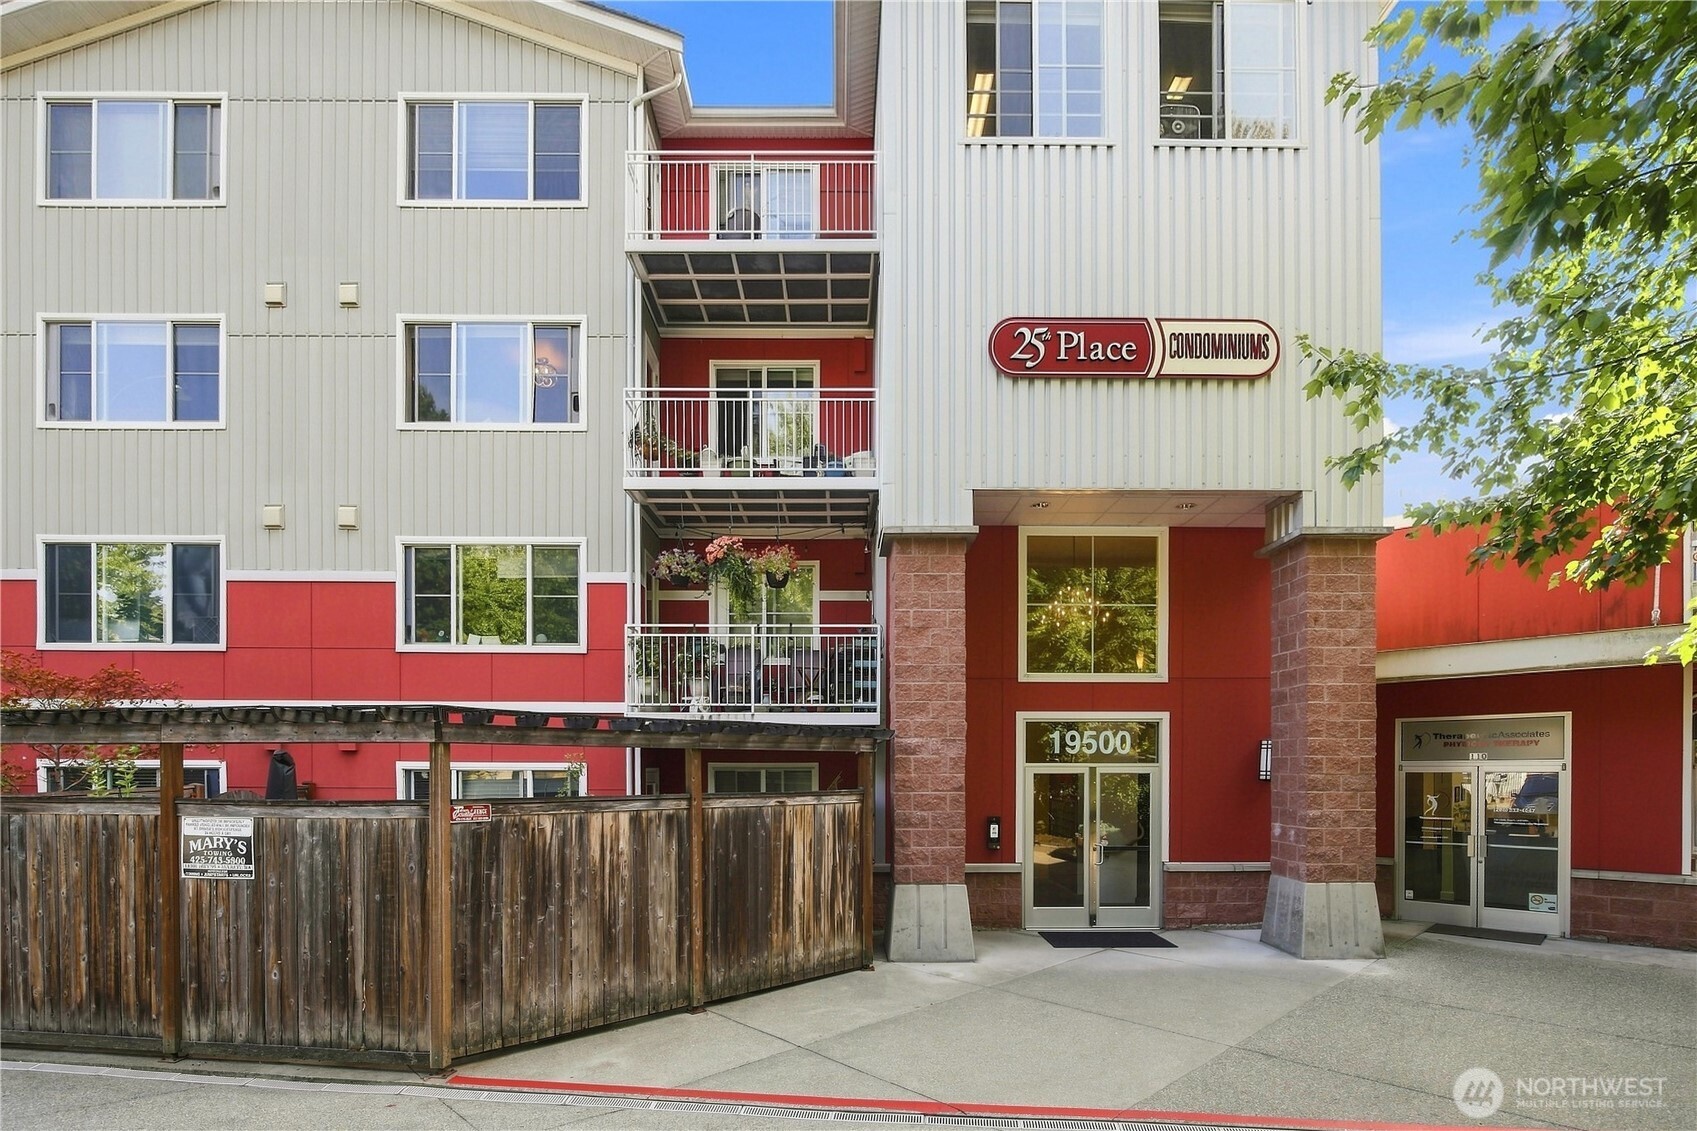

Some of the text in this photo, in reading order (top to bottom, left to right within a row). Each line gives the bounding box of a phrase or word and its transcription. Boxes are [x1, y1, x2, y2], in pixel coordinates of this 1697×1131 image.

[1056, 331, 1138, 361] Place
[1169, 332, 1270, 360] CONDOMINIUMS
[1051, 730, 1131, 754] 19500
[1469, 752, 1488, 760] 110
[189, 836, 247, 854] MARY'S
